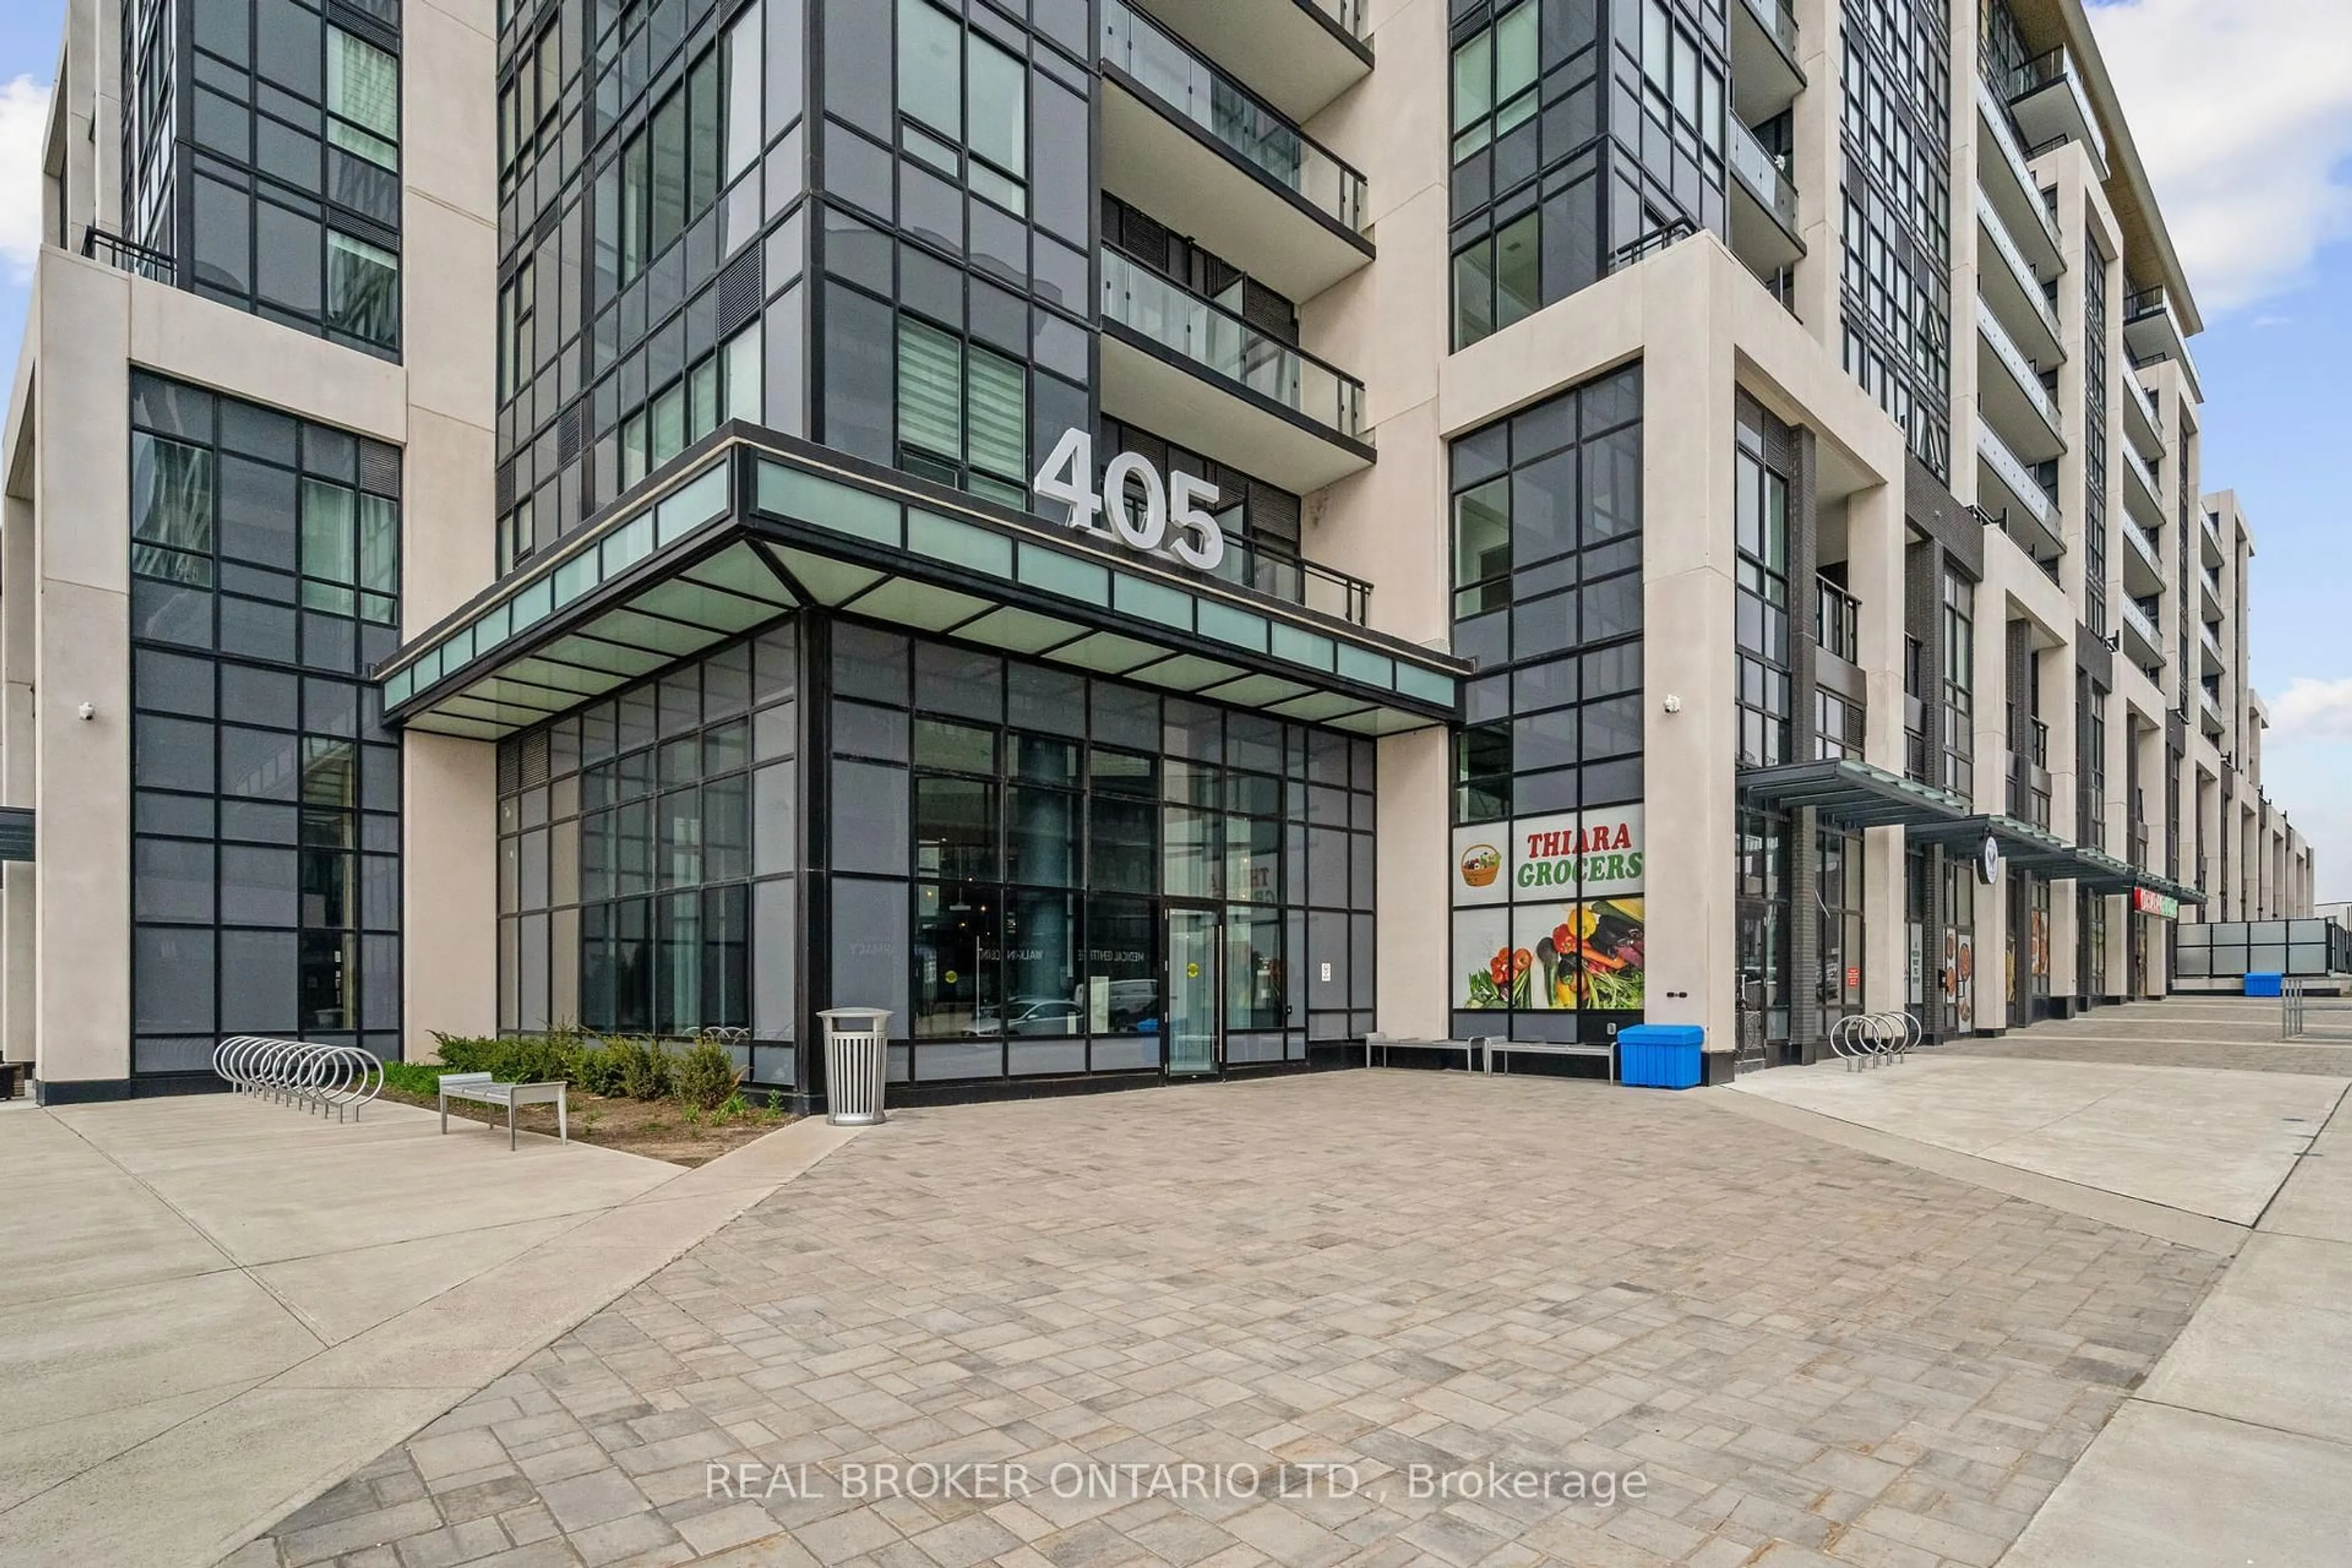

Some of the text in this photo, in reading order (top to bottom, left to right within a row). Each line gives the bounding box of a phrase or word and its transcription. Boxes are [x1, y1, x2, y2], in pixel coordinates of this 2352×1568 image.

[1034, 427, 1224, 570] 405
[1527, 823, 1632, 858] THIARA
[1517, 852, 1643, 888] GROCERS
